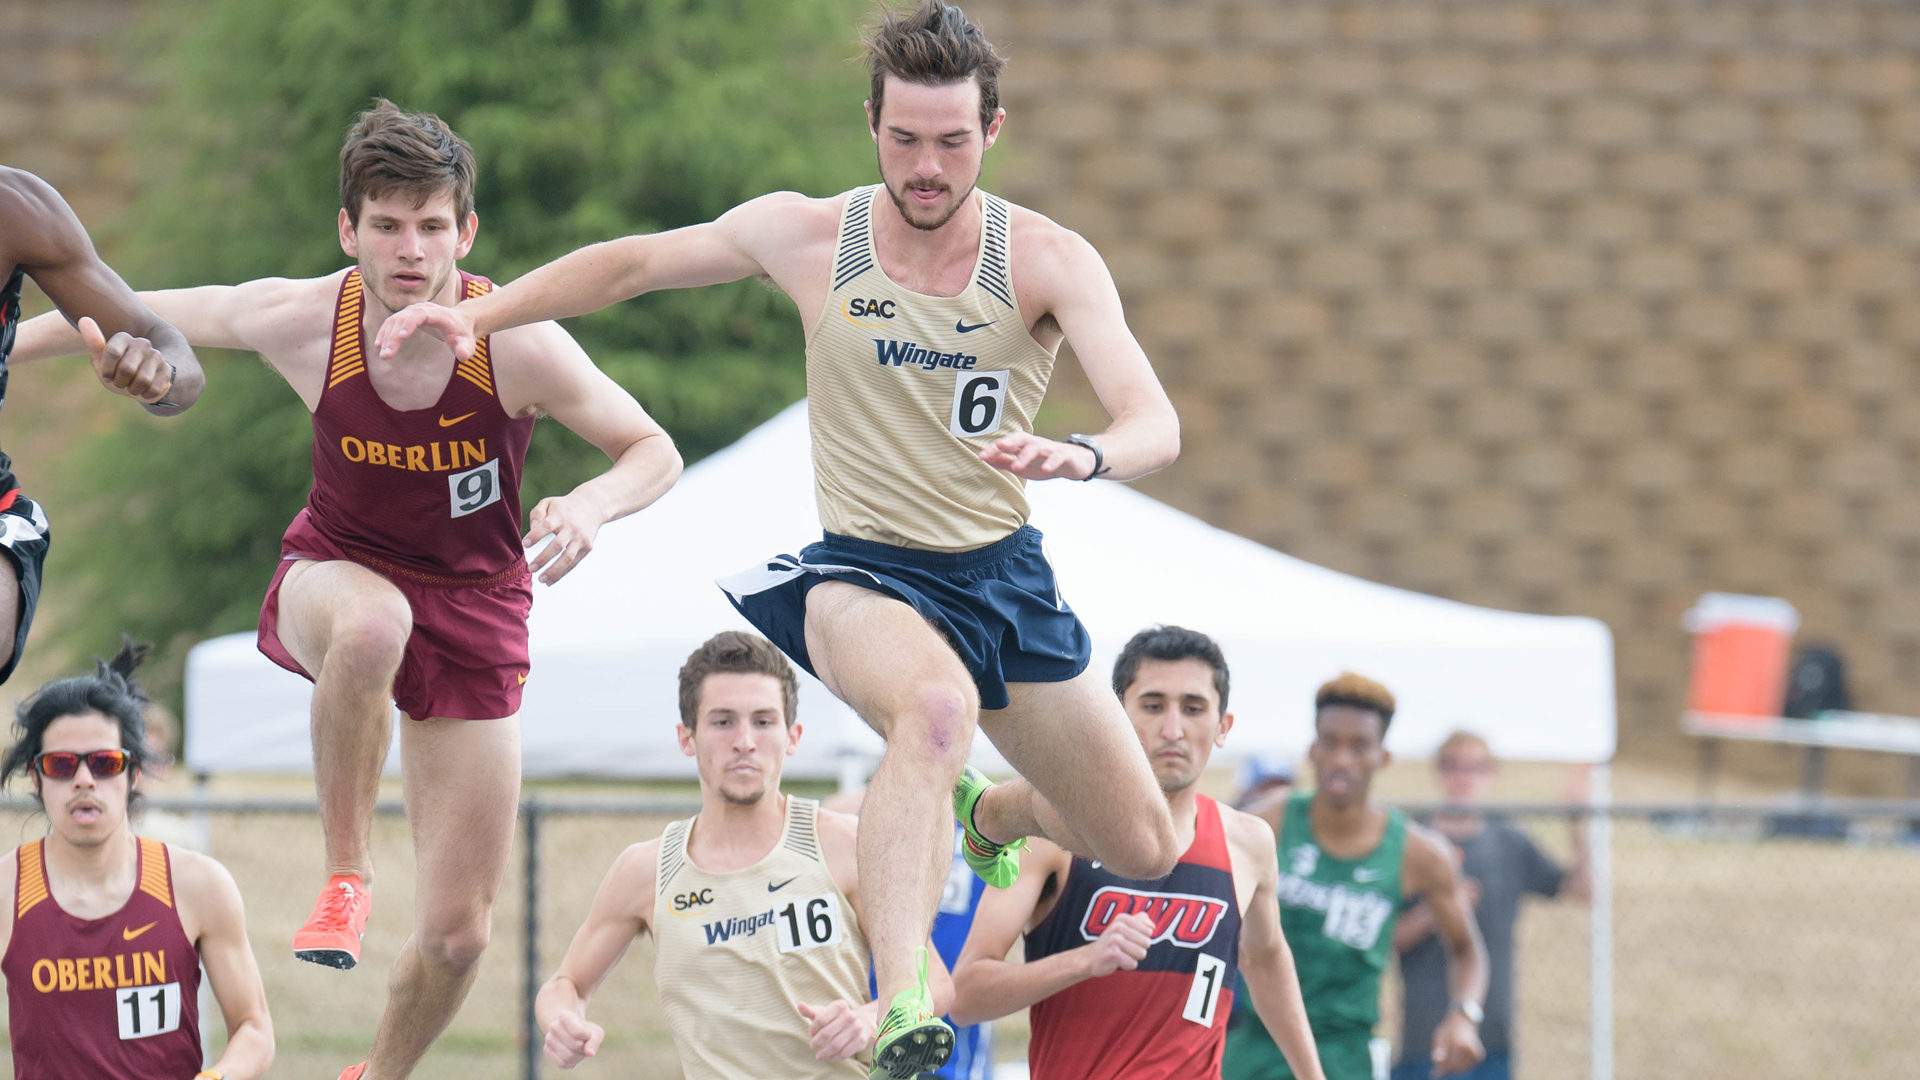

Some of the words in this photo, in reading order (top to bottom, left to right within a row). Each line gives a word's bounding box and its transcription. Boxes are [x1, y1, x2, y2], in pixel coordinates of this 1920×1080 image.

[849, 298, 896, 319] SAC
[871, 338, 977, 370] Wingate
[958, 376, 999, 433] 6
[341, 436, 486, 472] OBERLIN
[457, 469, 492, 511] 9
[674, 888, 714, 911] SAC
[1082, 888, 1226, 947] OWU
[702, 909, 775, 945] Wingat
[780, 898, 833, 947] 16
[32, 949, 166, 993] OBERLIN
[1203, 965, 1217, 1018] 1
[123, 988, 165, 1034] 11
